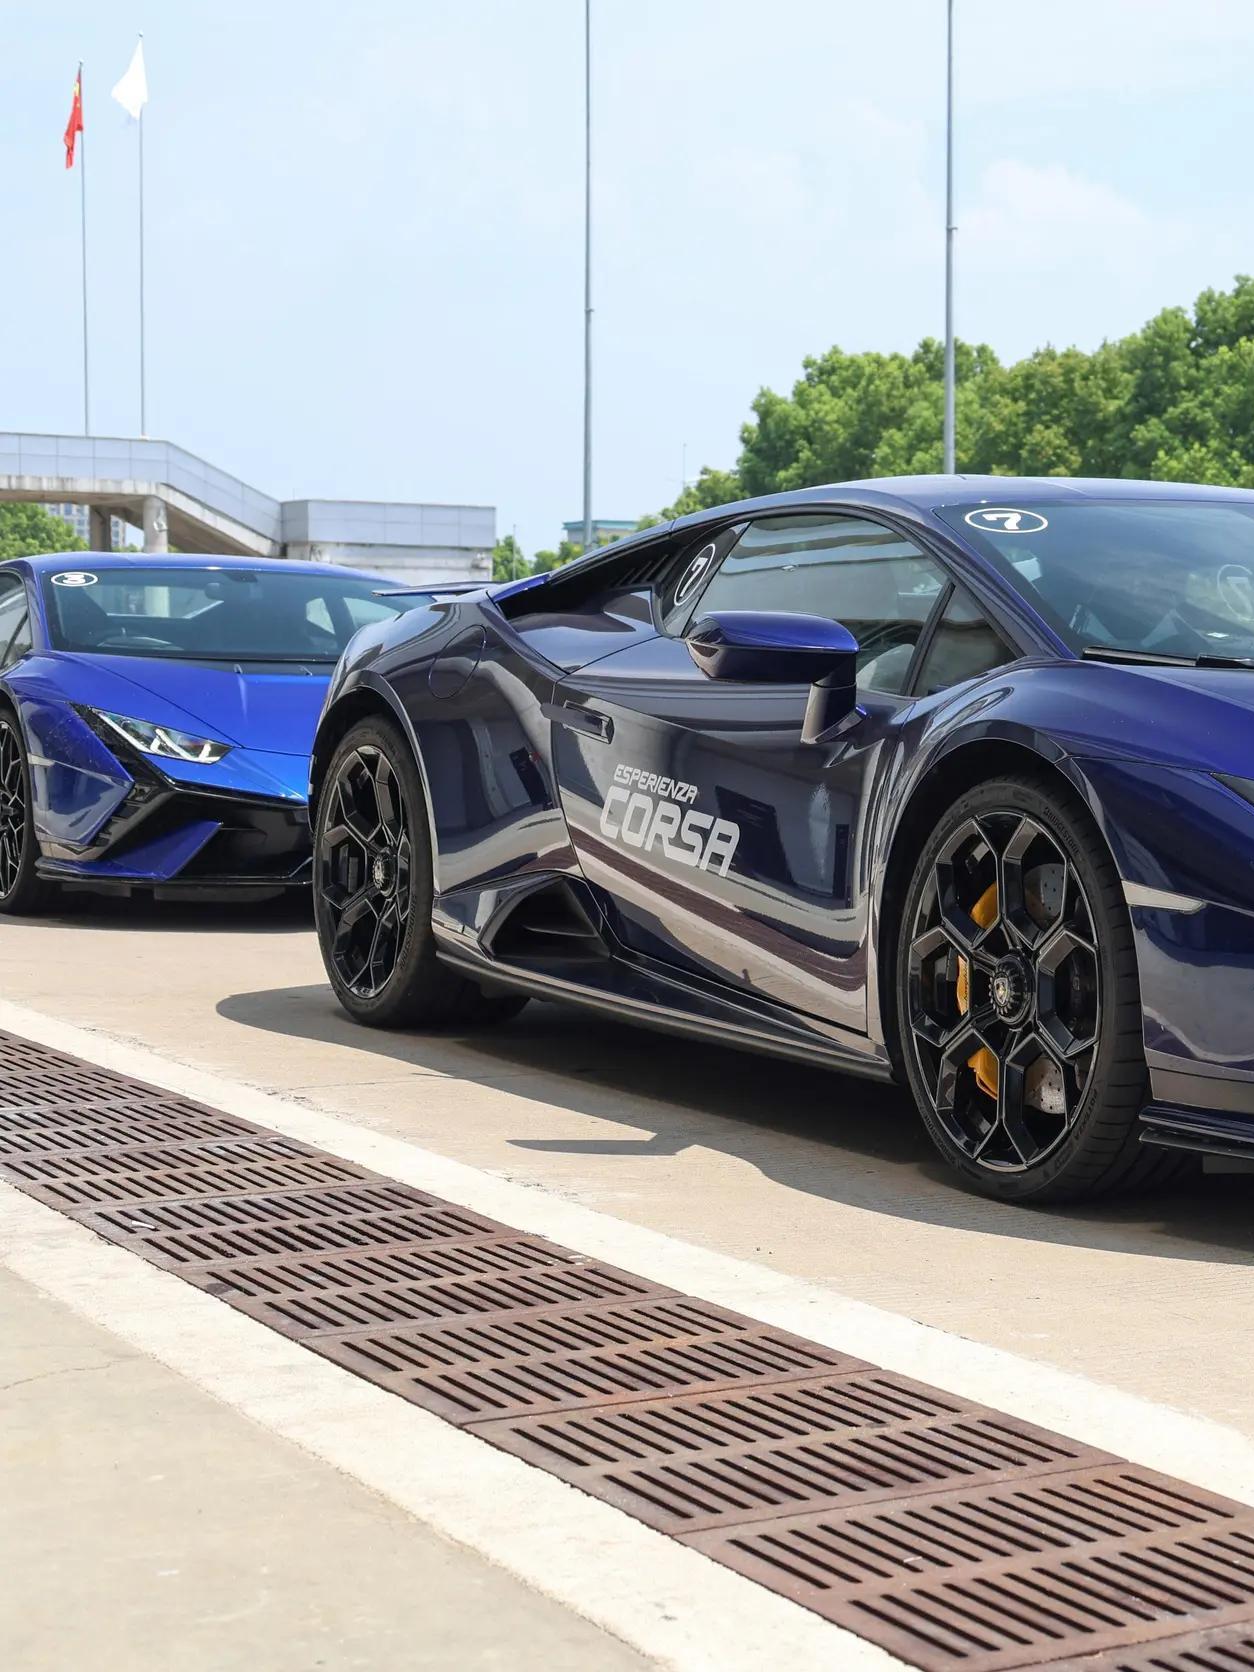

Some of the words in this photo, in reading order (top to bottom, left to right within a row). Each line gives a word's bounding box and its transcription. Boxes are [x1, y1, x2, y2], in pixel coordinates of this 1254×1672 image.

[679, 557, 708, 597] 7
[614, 764, 698, 804] ESPERIENZA
[600, 785, 740, 878] CORSA
